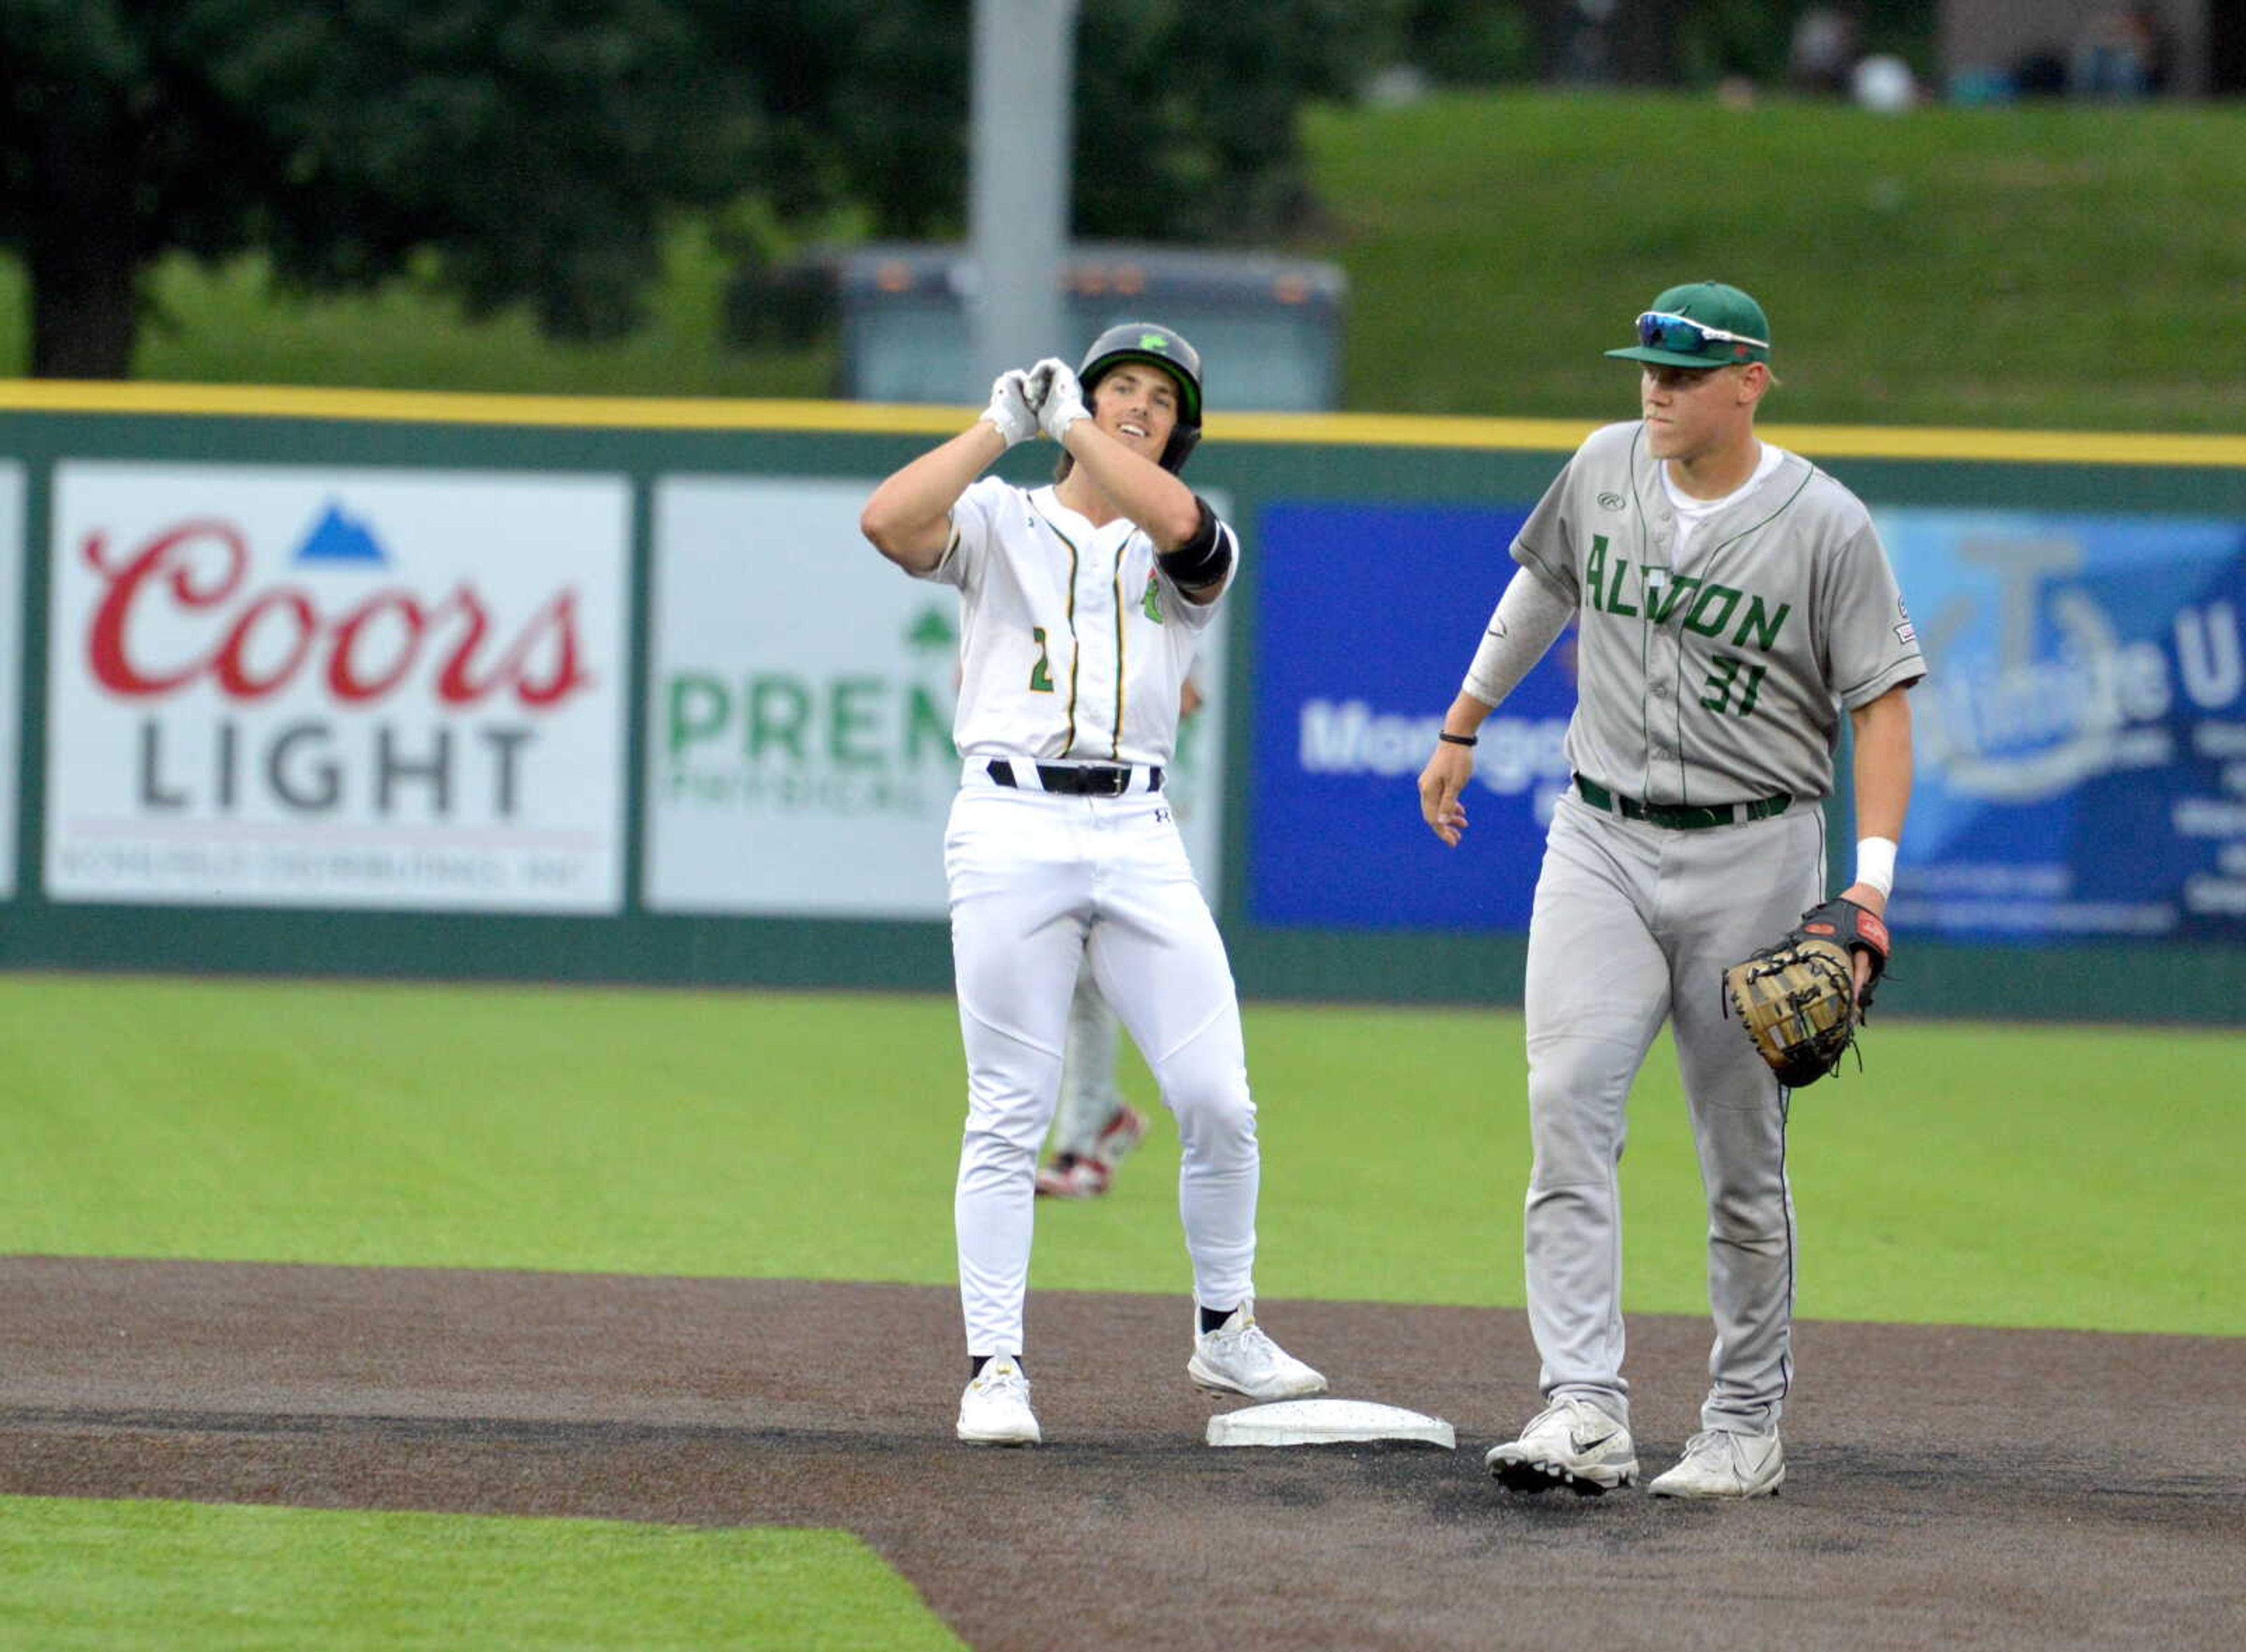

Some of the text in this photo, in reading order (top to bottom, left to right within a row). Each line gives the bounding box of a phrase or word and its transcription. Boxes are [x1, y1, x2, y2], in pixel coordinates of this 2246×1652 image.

[82, 516, 595, 711] Coors
[1586, 533, 1791, 652] ALTON
[1029, 626, 1054, 692] 2
[139, 717, 537, 819] LIGHT
